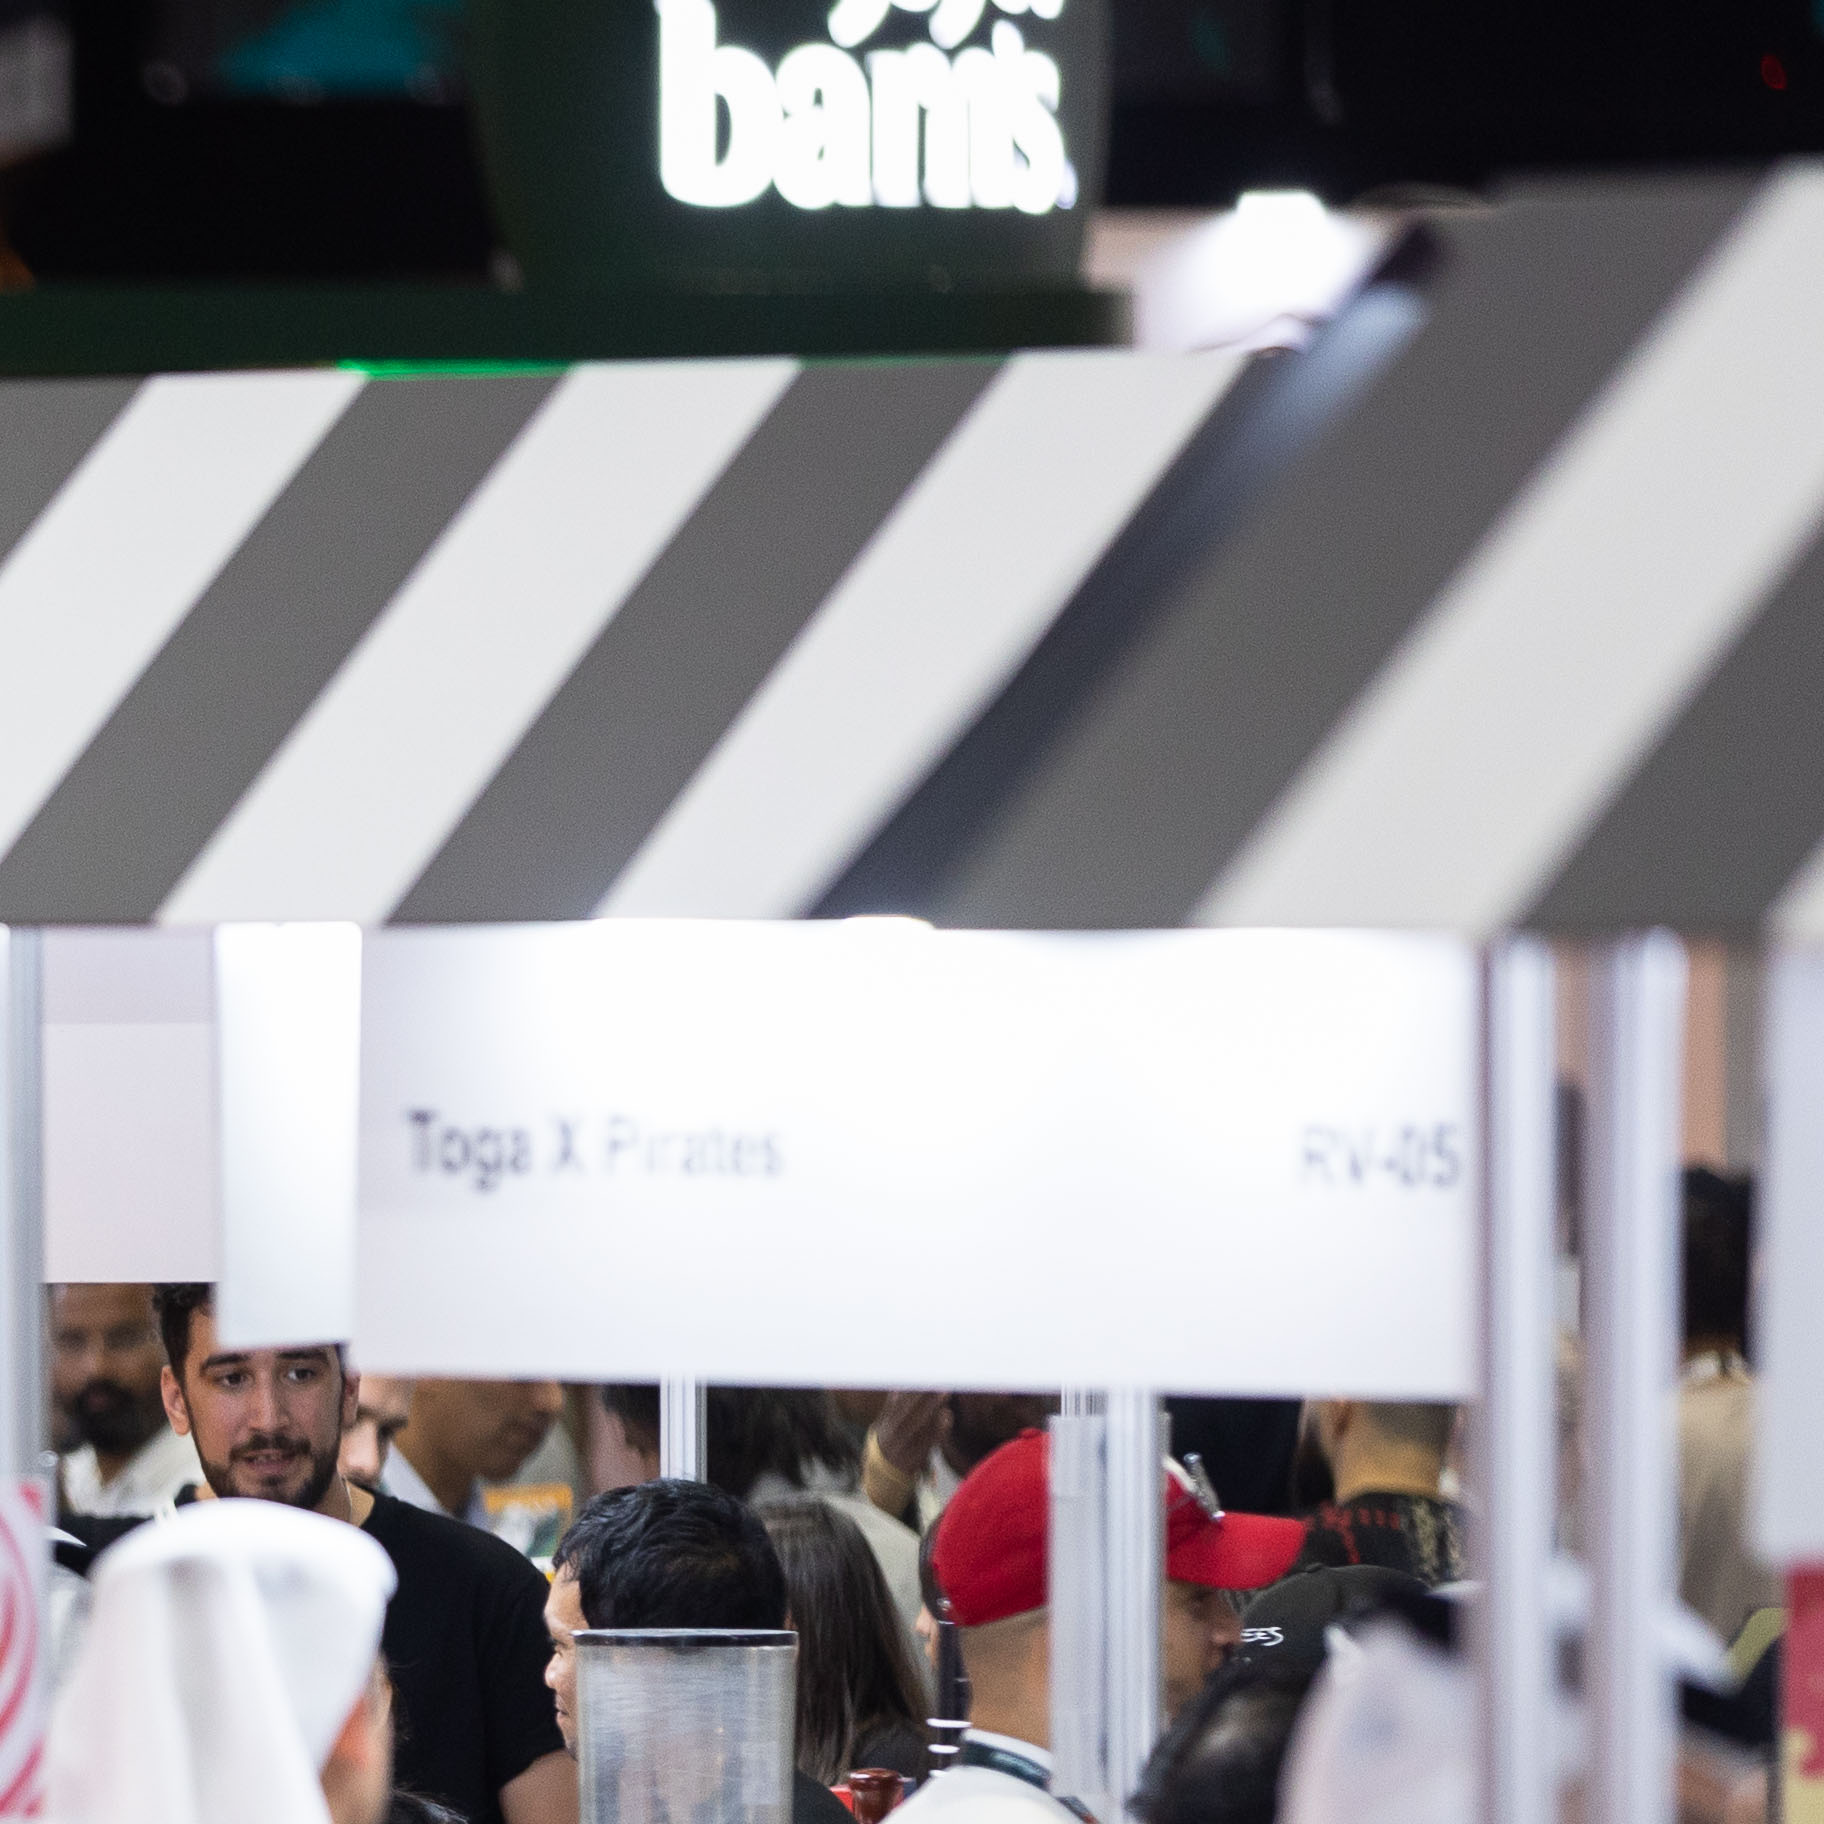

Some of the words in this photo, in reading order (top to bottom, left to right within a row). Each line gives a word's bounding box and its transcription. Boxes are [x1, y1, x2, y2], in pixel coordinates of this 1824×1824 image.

[407, 1108, 534, 1194] Toga
[548, 1114, 590, 1174] X
[605, 1113, 786, 1178] Pirates
[1300, 1124, 1461, 1188] RV-05
